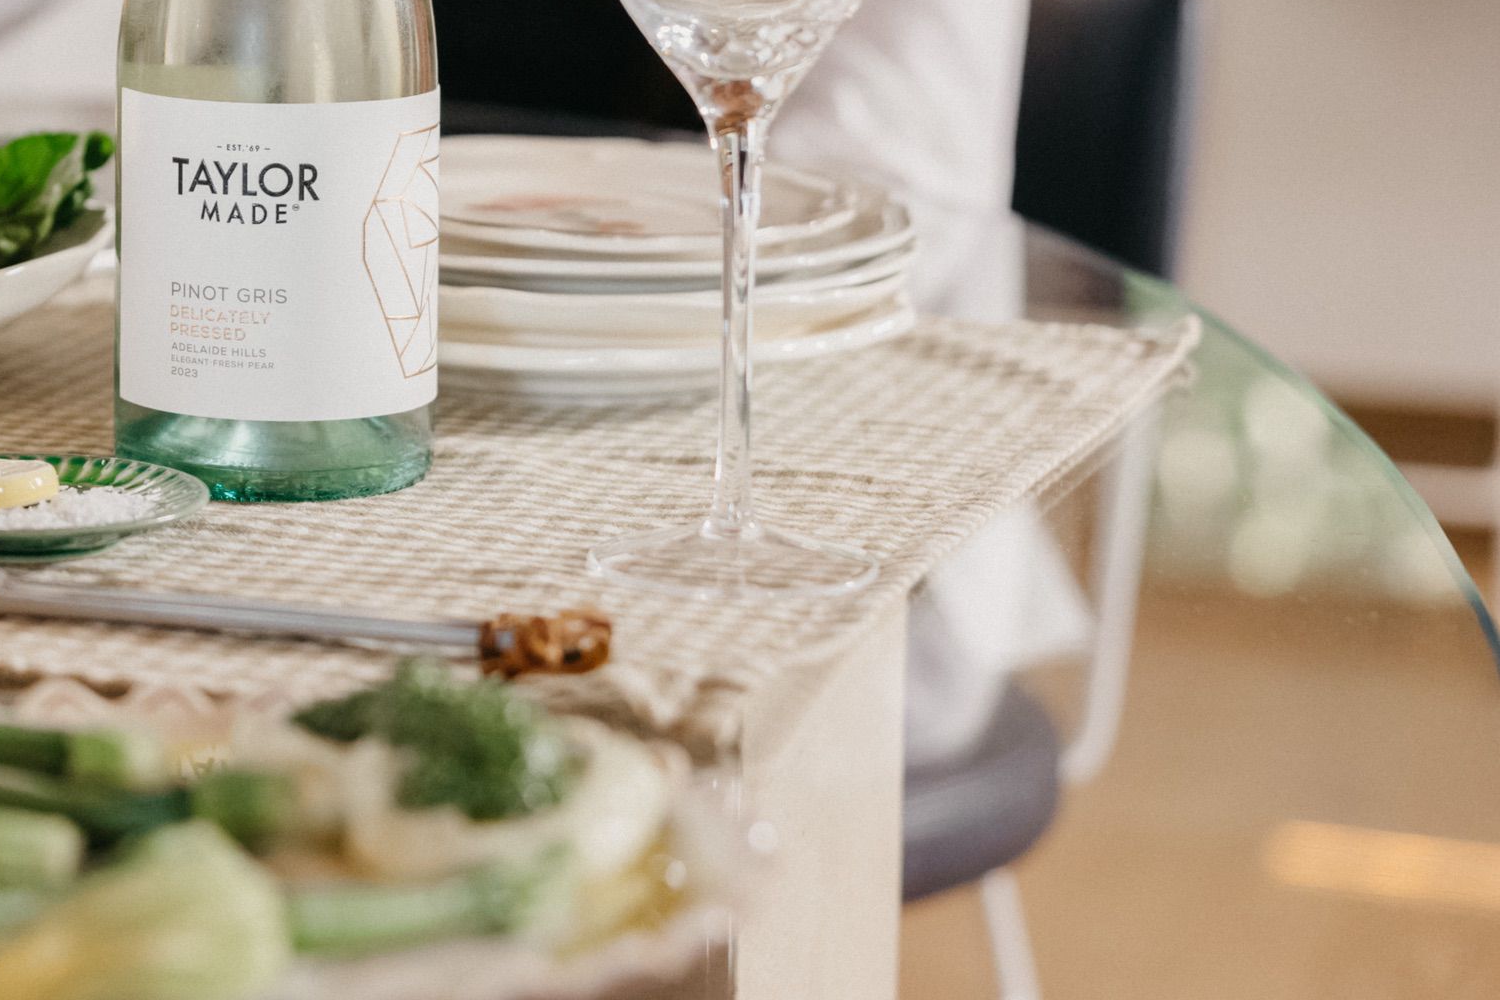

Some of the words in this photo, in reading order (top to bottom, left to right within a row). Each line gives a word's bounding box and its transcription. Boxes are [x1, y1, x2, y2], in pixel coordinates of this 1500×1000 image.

[172, 157, 320, 201] TAYLOR
[171, 281, 229, 301] PINOT
[236, 288, 288, 304] GRIS
[170, 304, 271, 325] DELICATELY
[170, 322, 246, 341] PRESSED
[171, 341, 227, 356] ADELAIDE
[231, 347, 267, 358] HILLS
[171, 366, 198, 378] 2023
[212, 359, 244, 368] FRESH
[248, 361, 275, 370] PEAR
